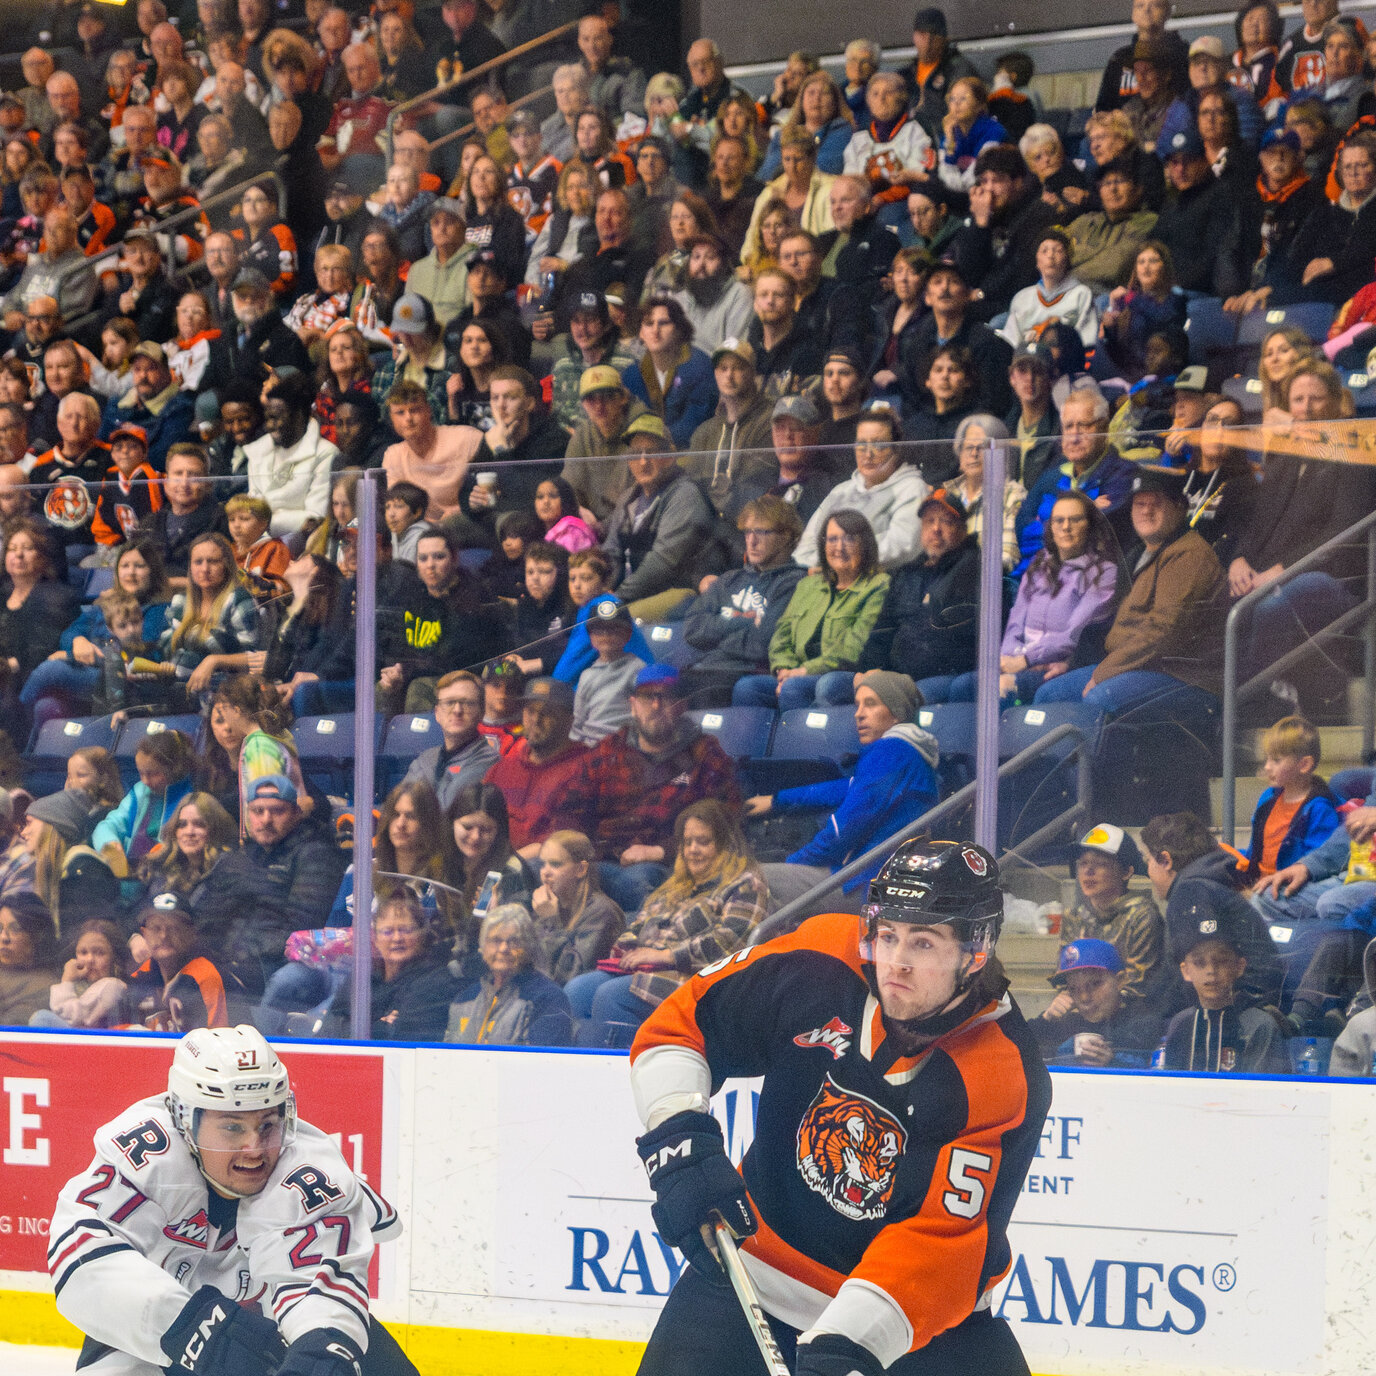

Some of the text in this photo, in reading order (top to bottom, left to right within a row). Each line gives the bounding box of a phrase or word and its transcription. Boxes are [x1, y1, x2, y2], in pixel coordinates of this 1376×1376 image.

[886, 886, 926, 899] CCM
[234, 1049, 257, 1066] 27
[233, 1081, 271, 1091] CCM
[111, 1117, 171, 1171] R
[644, 1138, 692, 1179] CM
[75, 1163, 148, 1225] 27
[281, 1163, 346, 1215] R
[943, 1146, 993, 1220] 5
[282, 1215, 351, 1272] 27
[180, 1303, 227, 1372] CCM
